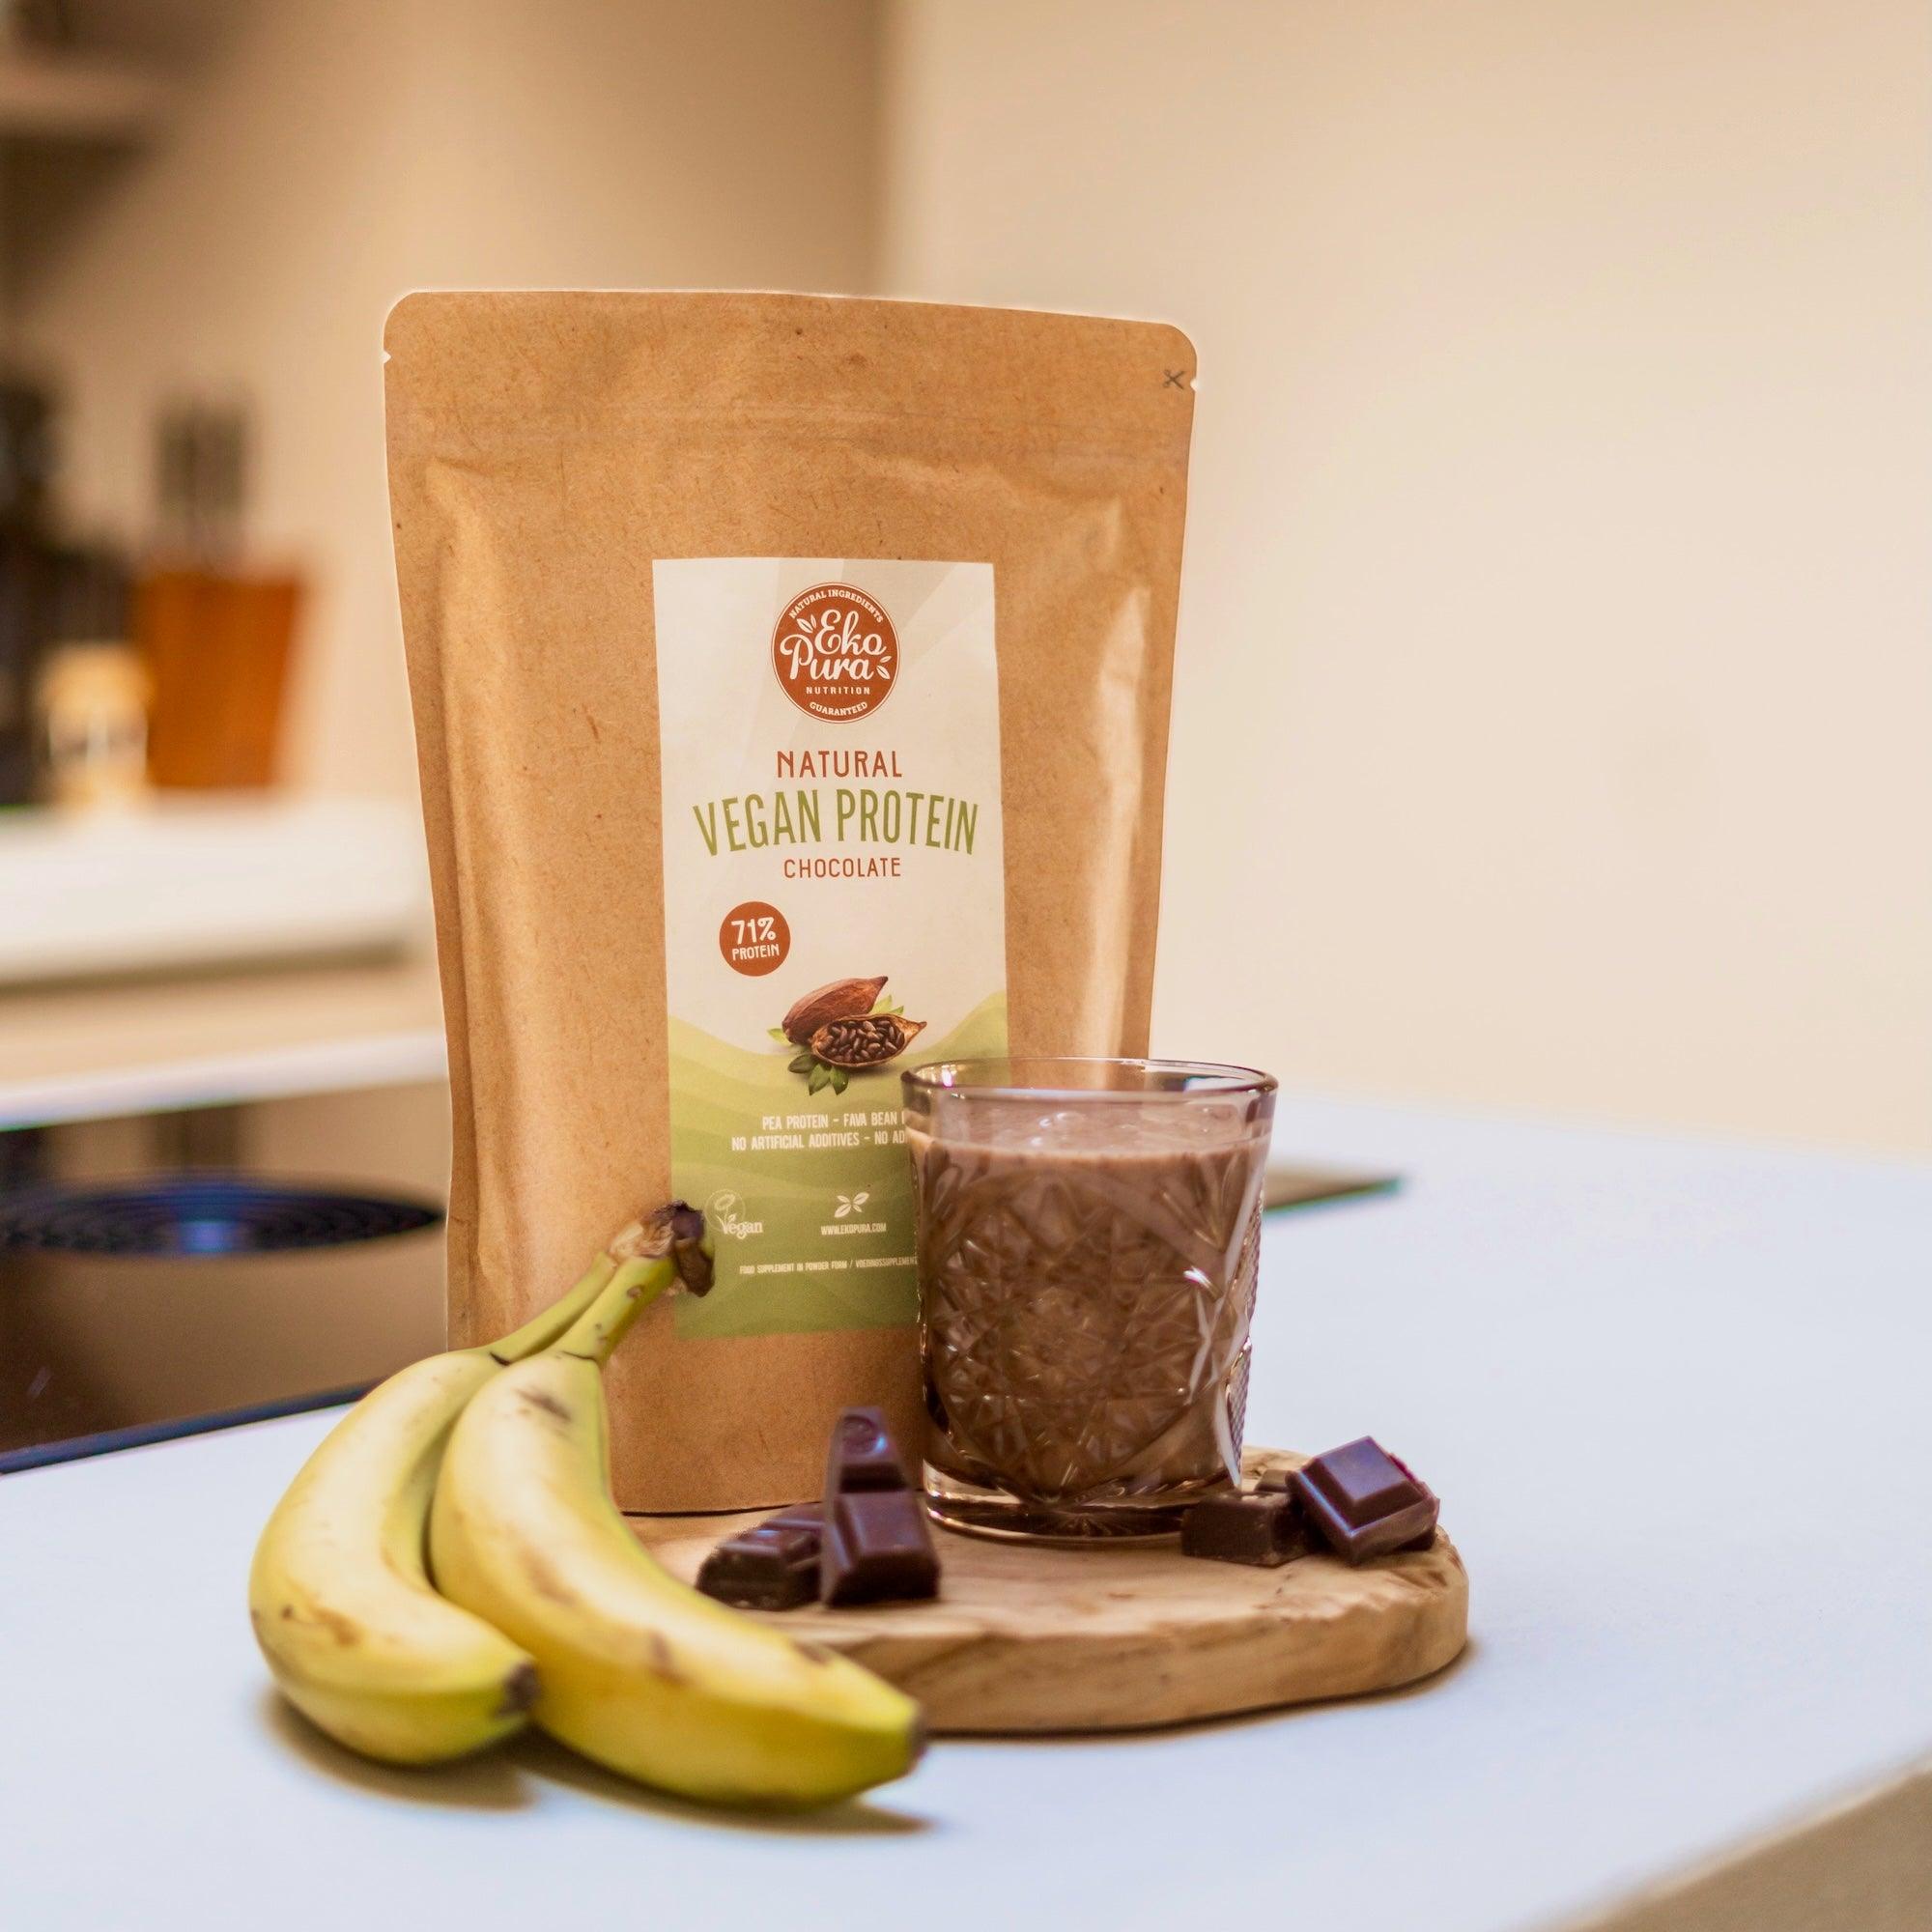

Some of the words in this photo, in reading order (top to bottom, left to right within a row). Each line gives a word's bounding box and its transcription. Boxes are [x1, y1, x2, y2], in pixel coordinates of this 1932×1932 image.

[788, 591, 827, 619] NATURAL
[828, 589, 884, 623] INGREDIENTS
[814, 609, 887, 655] Eko
[780, 634, 874, 680] Pura
[806, 686, 870, 695] NUTRITION
[810, 701, 867, 716] GUARANTEED
[777, 751, 902, 778] NATURAL
[693, 789, 821, 856] VEGAN
[837, 788, 978, 855] PROTEIN
[783, 858, 901, 878] CHOCOLATE
[731, 917, 777, 944] 71%
[732, 944, 780, 960] PROTEIN
[762, 1115, 782, 1130] PEA
[786, 1114, 829, 1128] PROTEIN
[843, 1113, 867, 1127] FAVA
[871, 1111, 897, 1125] BEAN
[731, 1136, 747, 1151] NO
[751, 1134, 805, 1151] ARTIFICIAL
[809, 1132, 860, 1148] ADDITIVES
[874, 1130, 889, 1145] NO
[892, 1129, 909, 1144] AD
[715, 1212, 763, 1239] Vegan
[820, 1223, 887, 1236] WWW.EKOPURA.COM
[805, 1261, 829, 1271] POWDER
